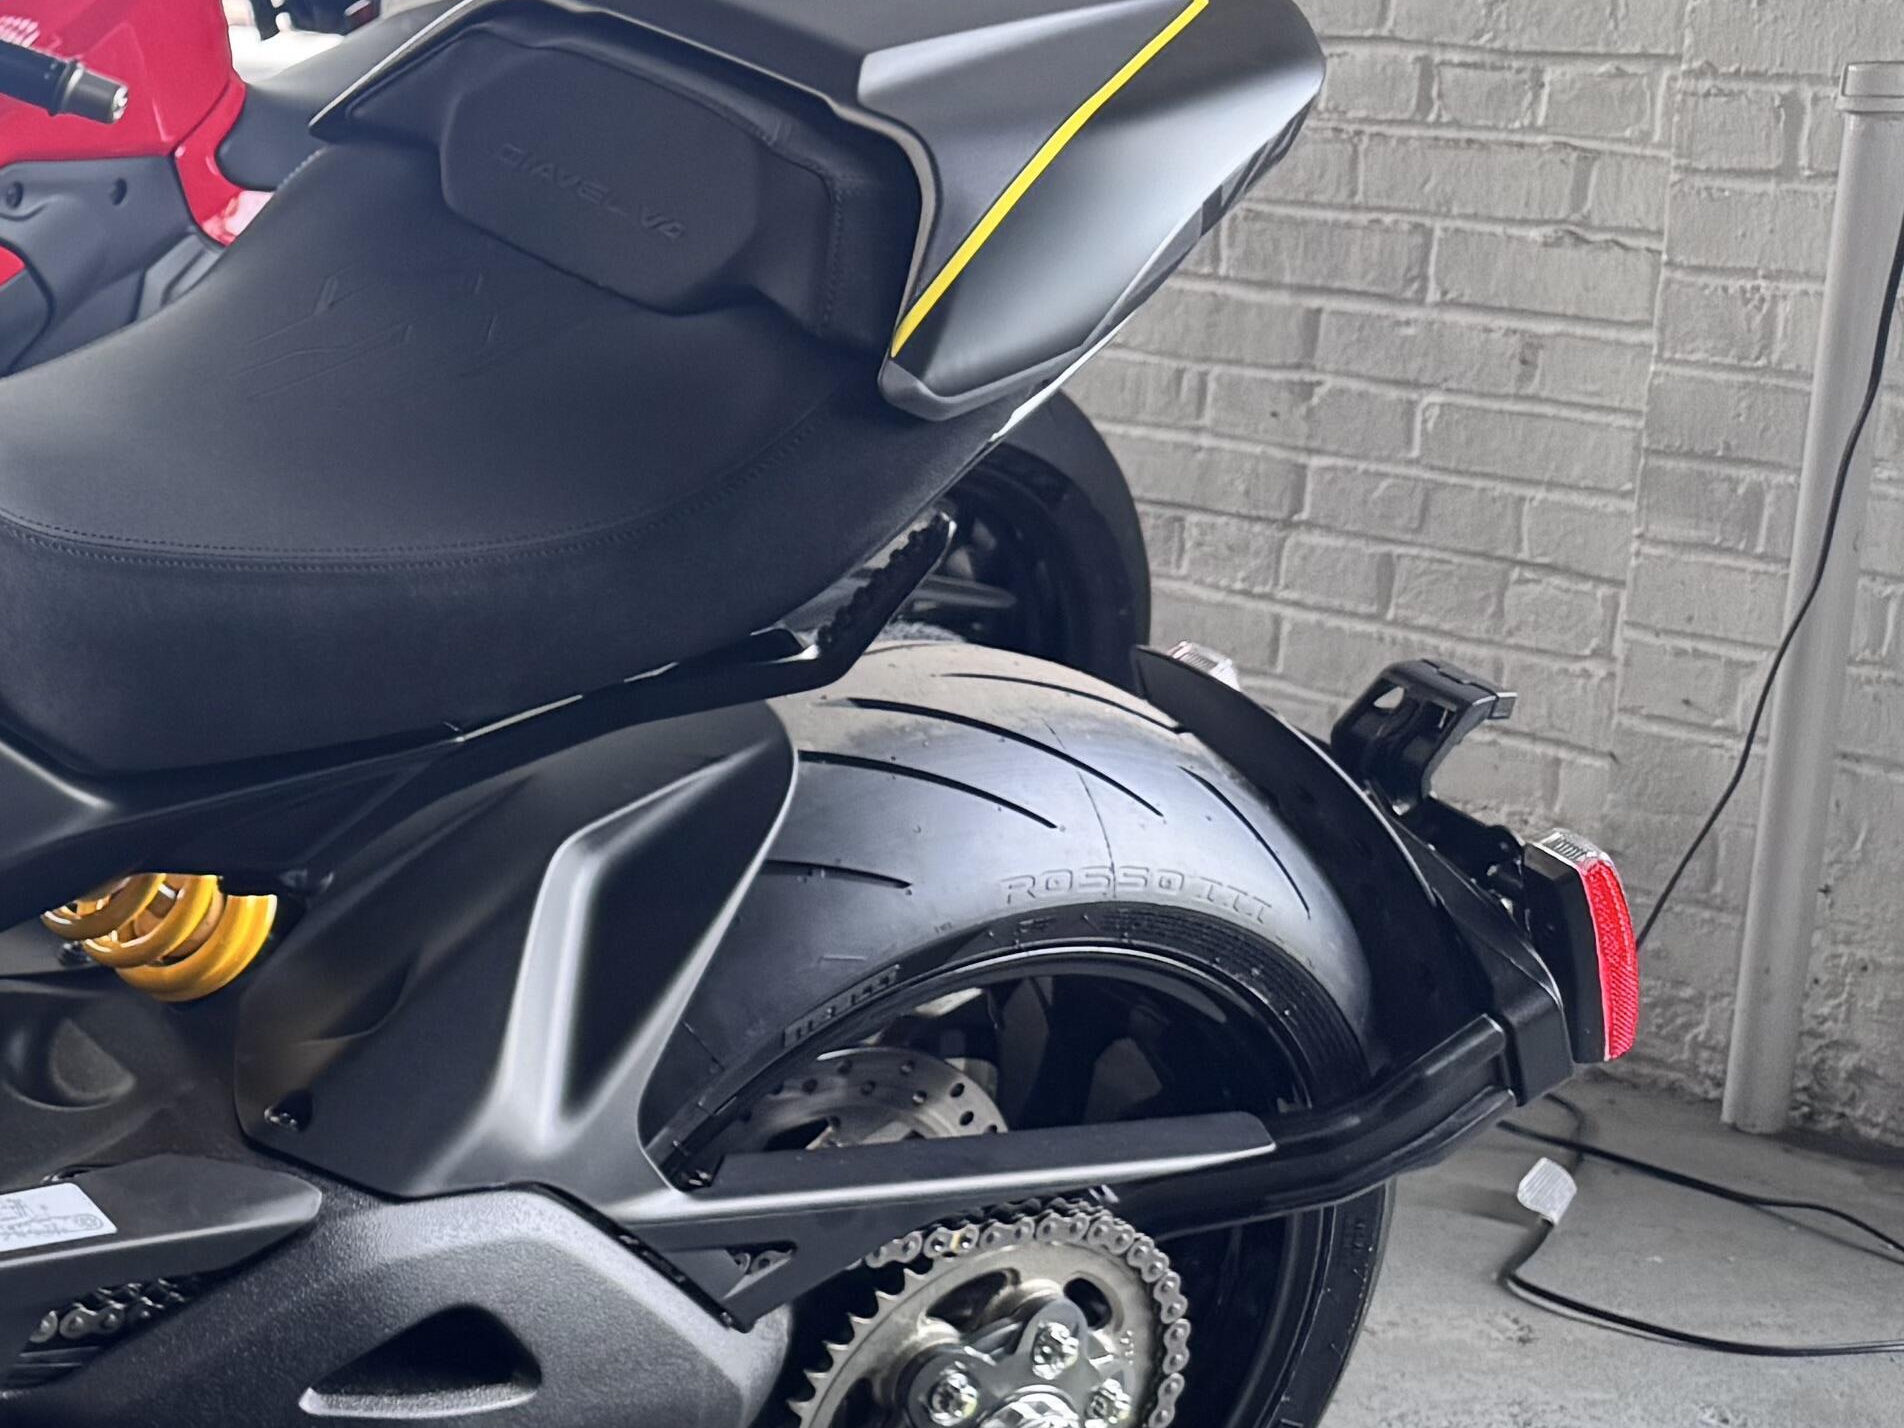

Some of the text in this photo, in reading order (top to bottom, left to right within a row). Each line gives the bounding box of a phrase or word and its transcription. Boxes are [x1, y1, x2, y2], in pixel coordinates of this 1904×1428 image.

[494, 142, 630, 217] DIAVEL
[1000, 864, 1273, 924] ROSSO III
